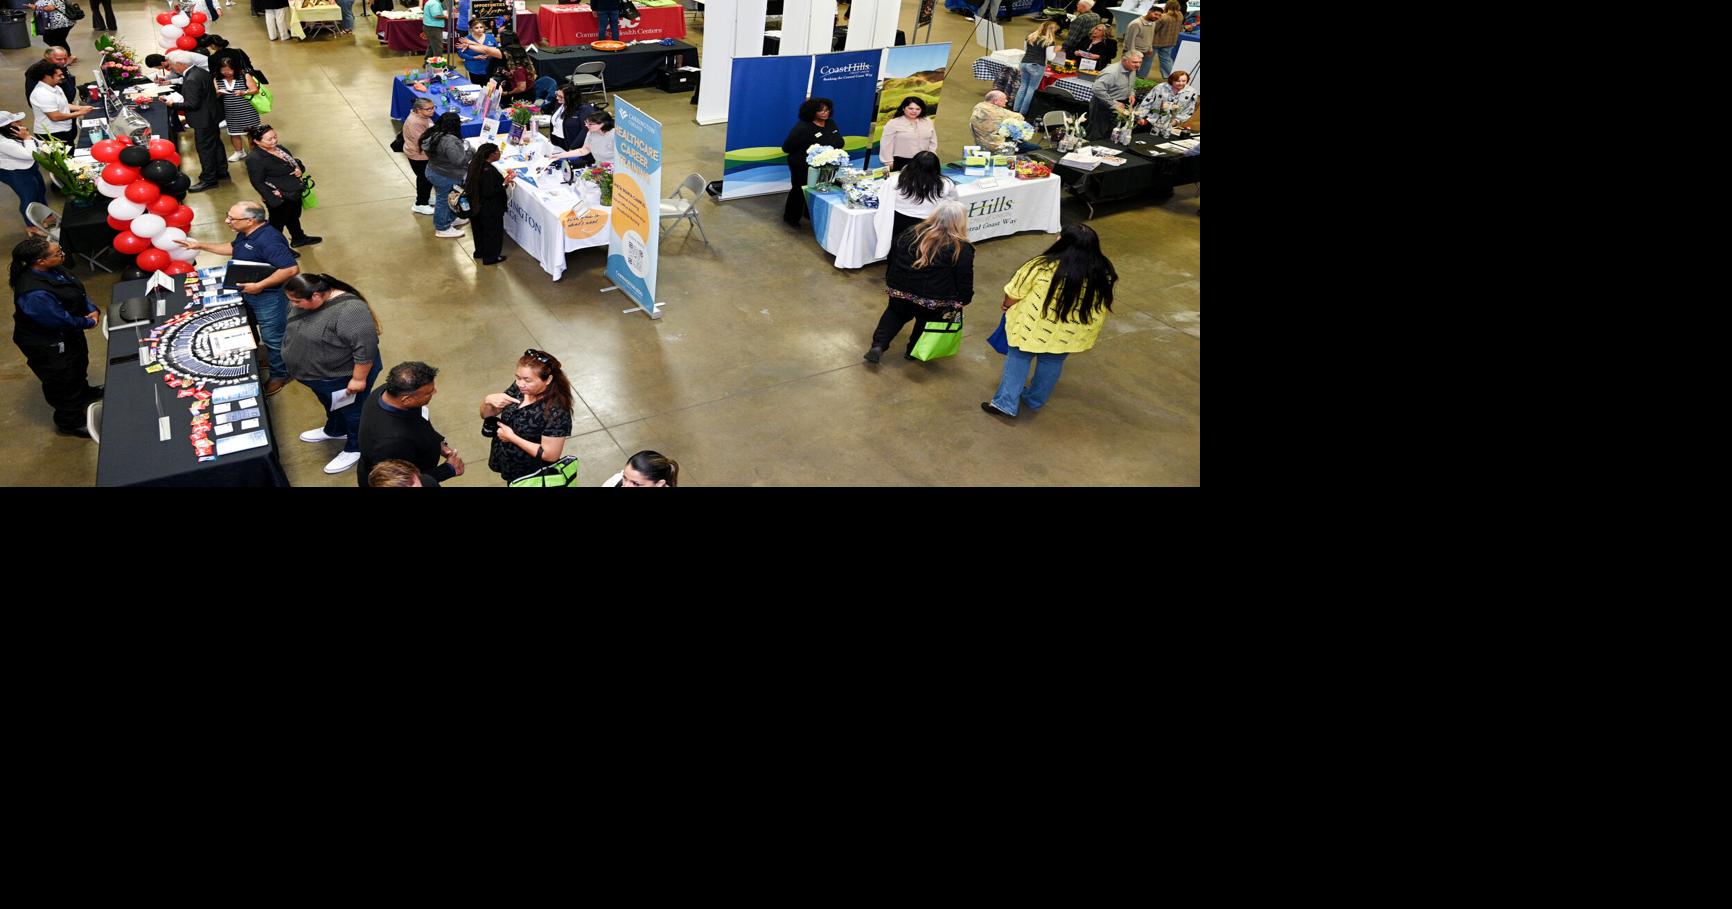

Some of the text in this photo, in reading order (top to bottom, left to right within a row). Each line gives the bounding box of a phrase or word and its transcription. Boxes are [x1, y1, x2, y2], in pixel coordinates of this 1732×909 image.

[820, 62, 871, 75] CoastHills
[615, 123, 659, 161] HEALTHCARE
[620, 143, 648, 169] CAREER
[508, 199, 542, 234] INGTON
[968, 196, 1013, 217] Hills
[982, 221, 1000, 229] Coast
